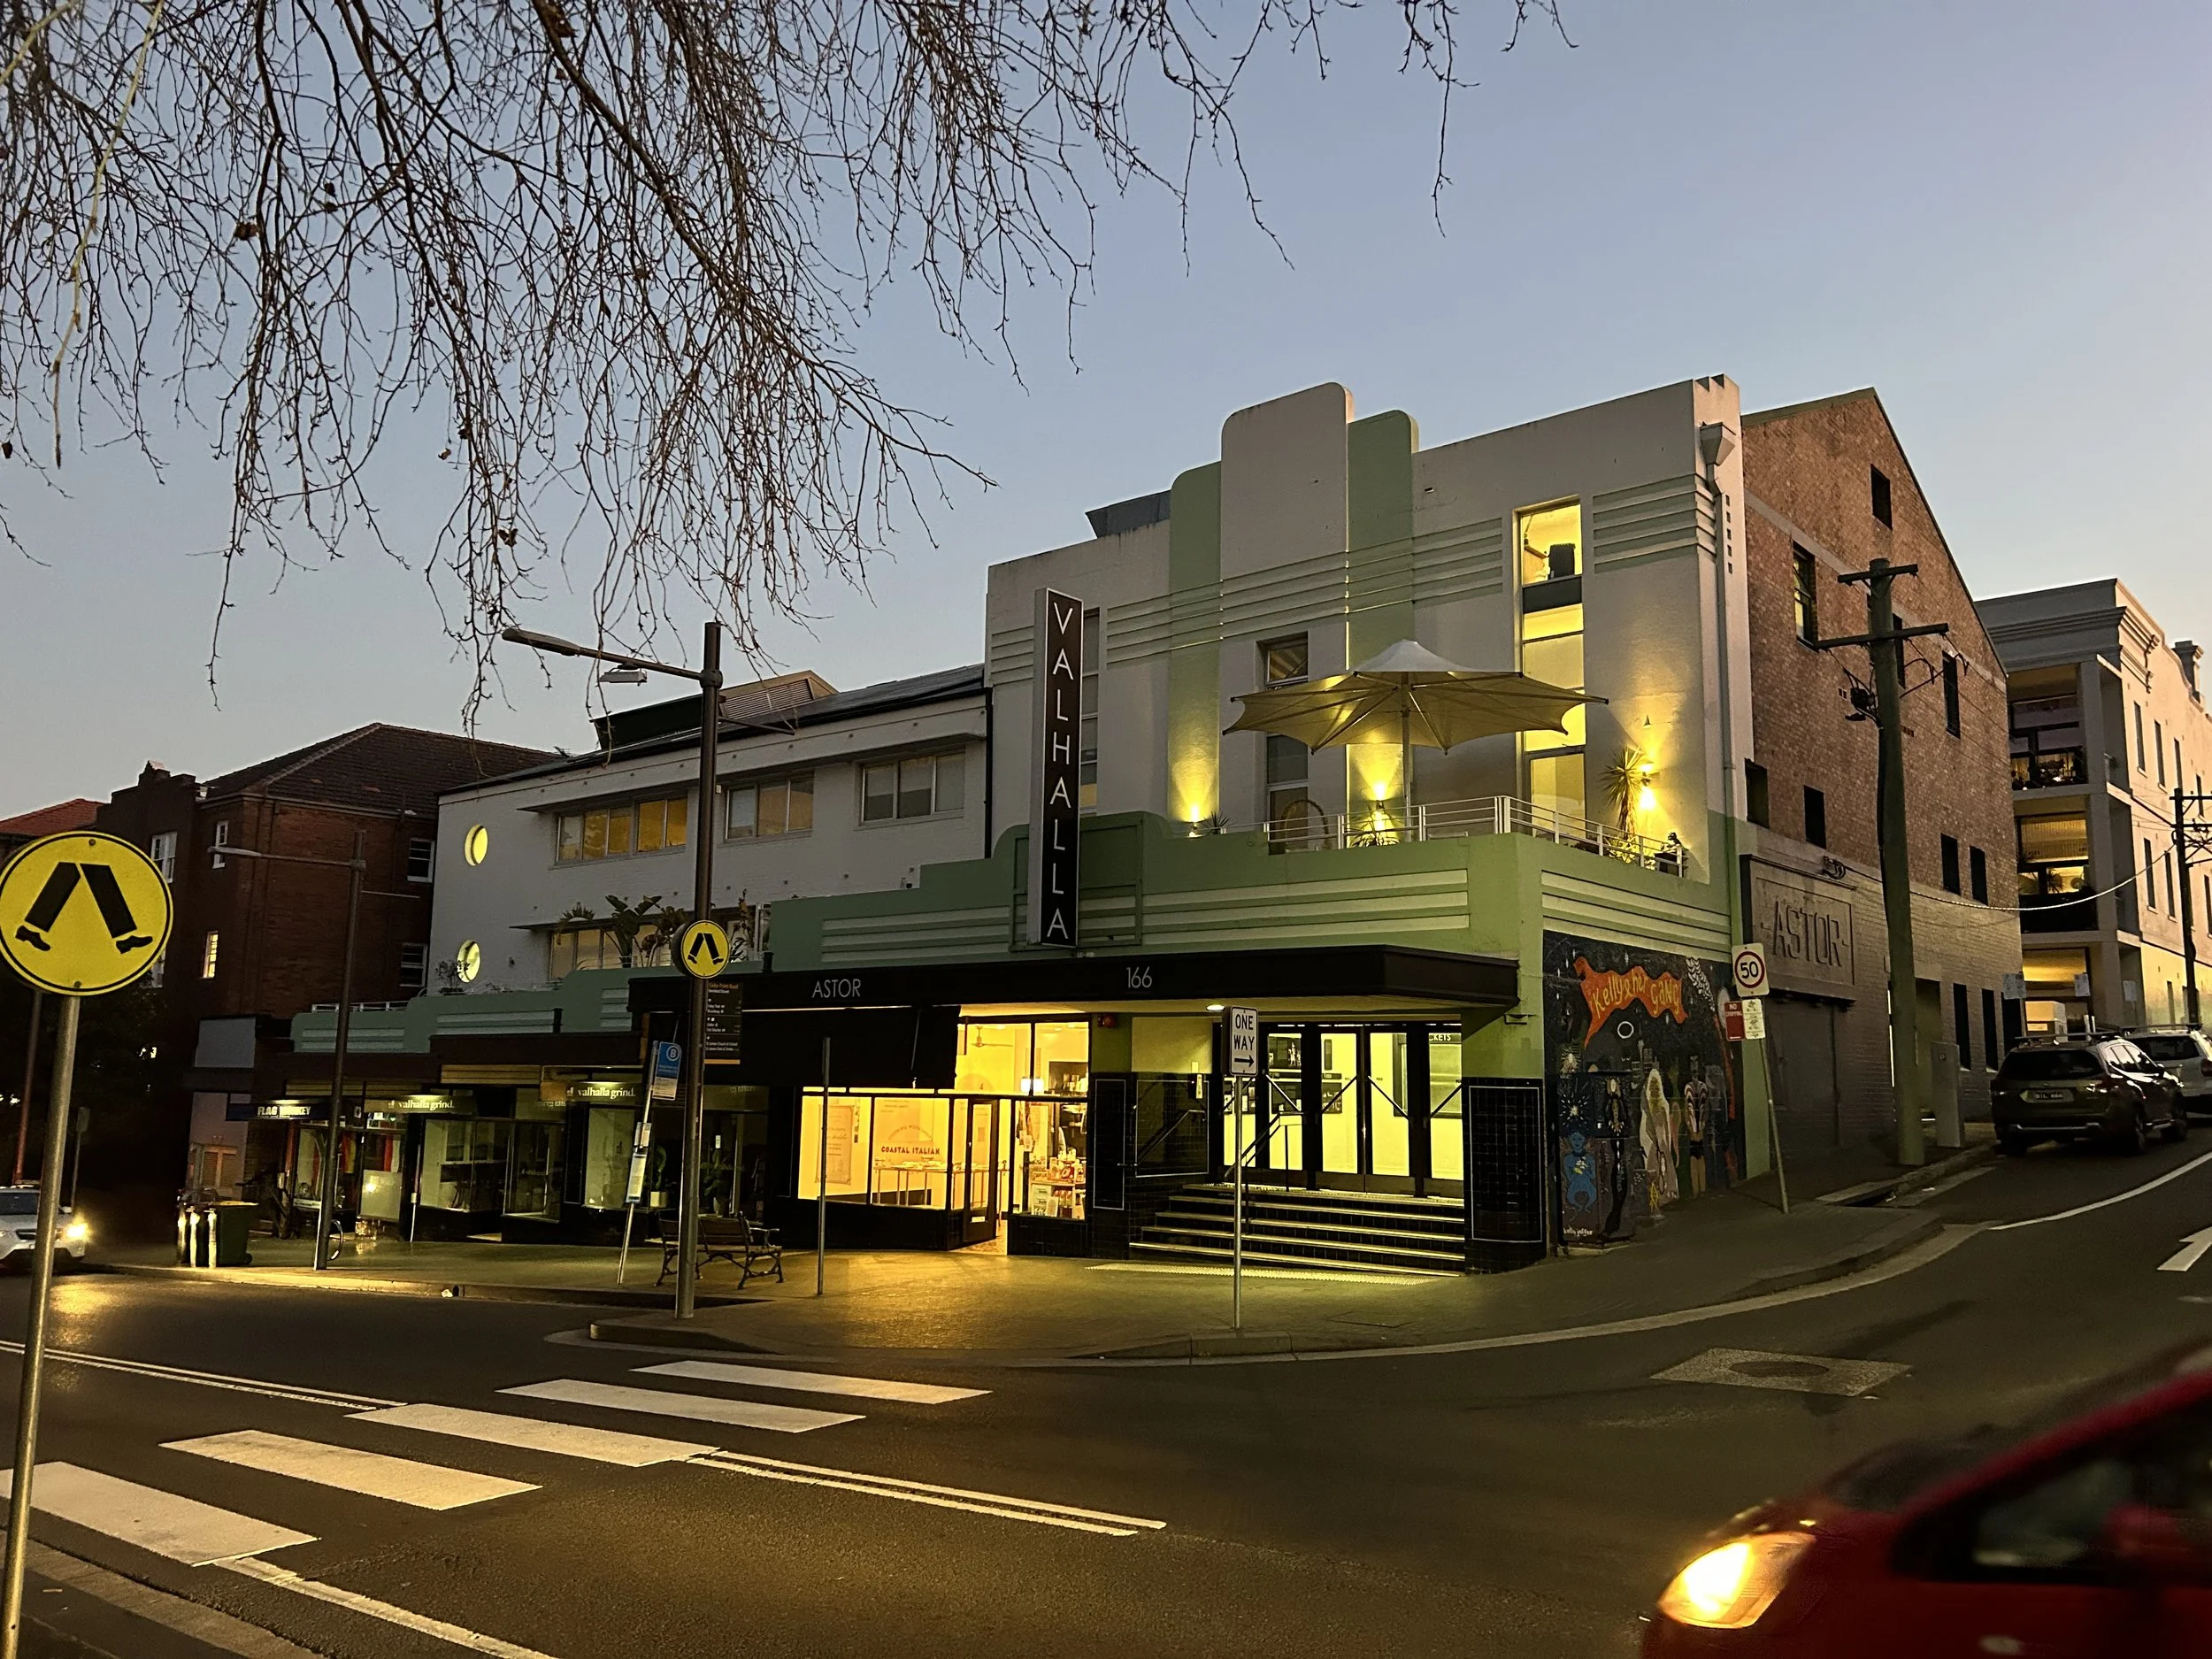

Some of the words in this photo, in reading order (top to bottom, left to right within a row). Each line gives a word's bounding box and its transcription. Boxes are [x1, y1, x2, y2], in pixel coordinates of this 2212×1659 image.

[1046, 602, 1074, 940] VALHALLA
[1771, 897, 1842, 968] ASTOR
[1125, 965, 1153, 989] 166
[1739, 961, 1759, 979] 50
[810, 978, 862, 999] ASTOR
[1234, 1013, 1255, 1031] ONE
[1233, 1033, 1256, 1051] WAY
[1428, 1033, 1452, 1041] CKETS
[577, 1087, 610, 1097] valhalla
[257, 1105, 278, 1116] FLAG
[279, 1105, 311, 1117] KEY
[398, 1099, 429, 1109] valhalla
[880, 1146, 910, 1155] COASTAL
[912, 1147, 941, 1156] ITALIAN
